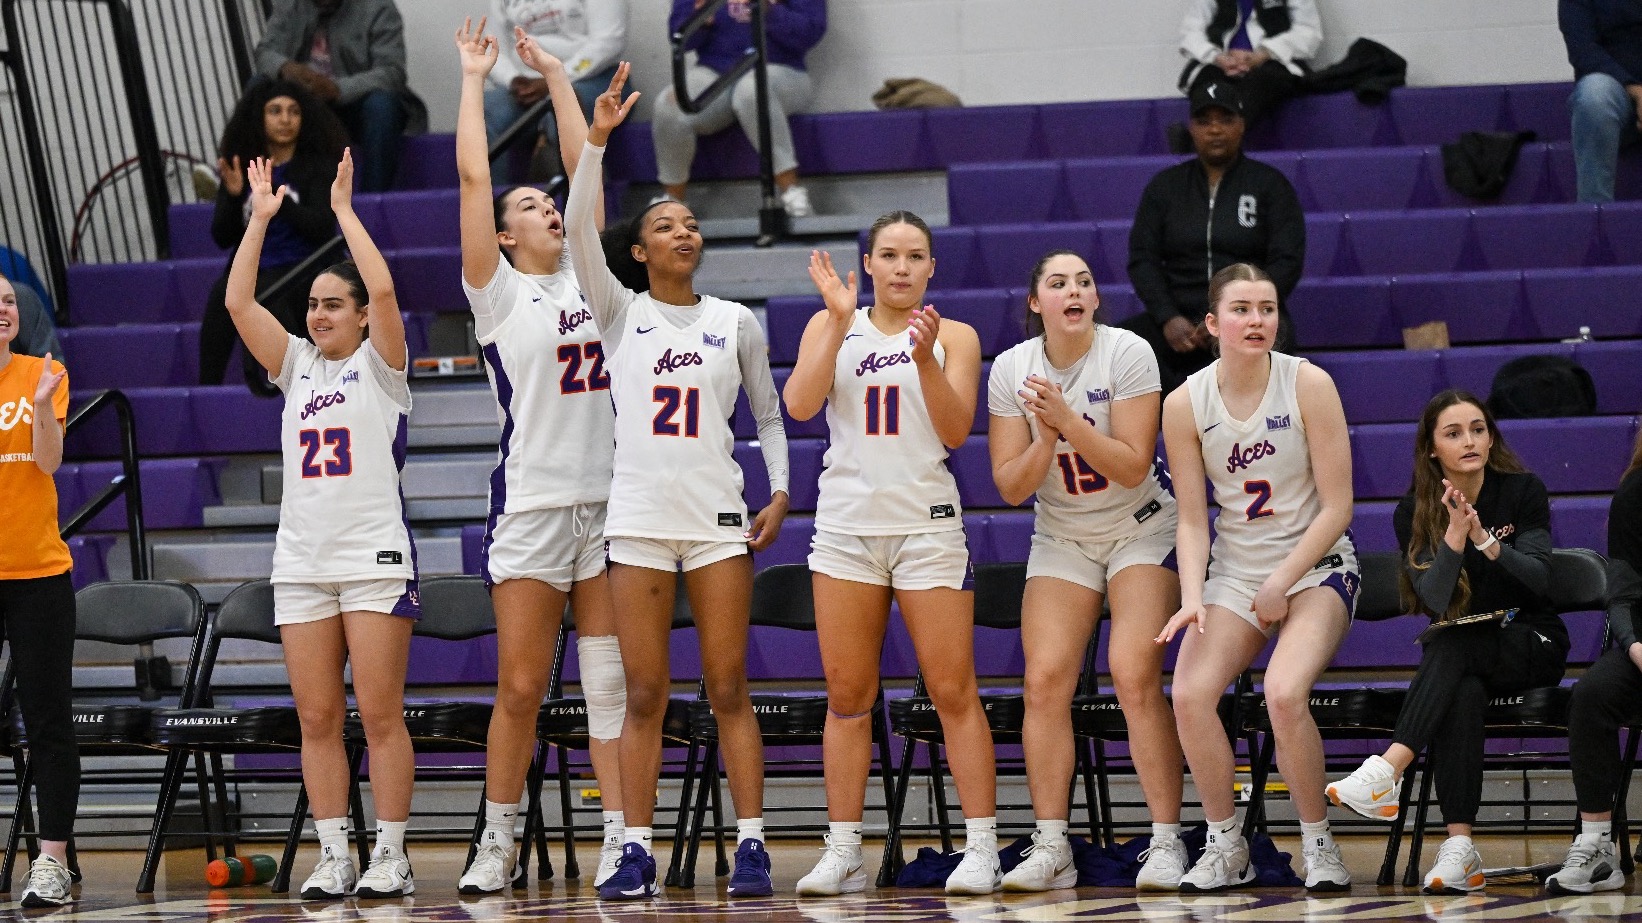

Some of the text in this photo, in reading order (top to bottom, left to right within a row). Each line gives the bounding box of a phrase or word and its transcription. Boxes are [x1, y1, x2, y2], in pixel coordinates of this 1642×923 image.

[558, 309, 593, 335] Aces
[557, 341, 611, 395] 22
[654, 348, 703, 375] Aces
[856, 351, 911, 377] Aces
[301, 390, 346, 420] Aces
[653, 385, 699, 438] 21
[864, 385, 899, 435] 11
[300, 427, 352, 478] 23
[1226, 440, 1276, 473] Aces
[1057, 452, 1109, 495] 15
[1244, 480, 1275, 521] 2
[165, 716, 239, 726] EVANSVILLE
[550, 706, 588, 715] EVAN
